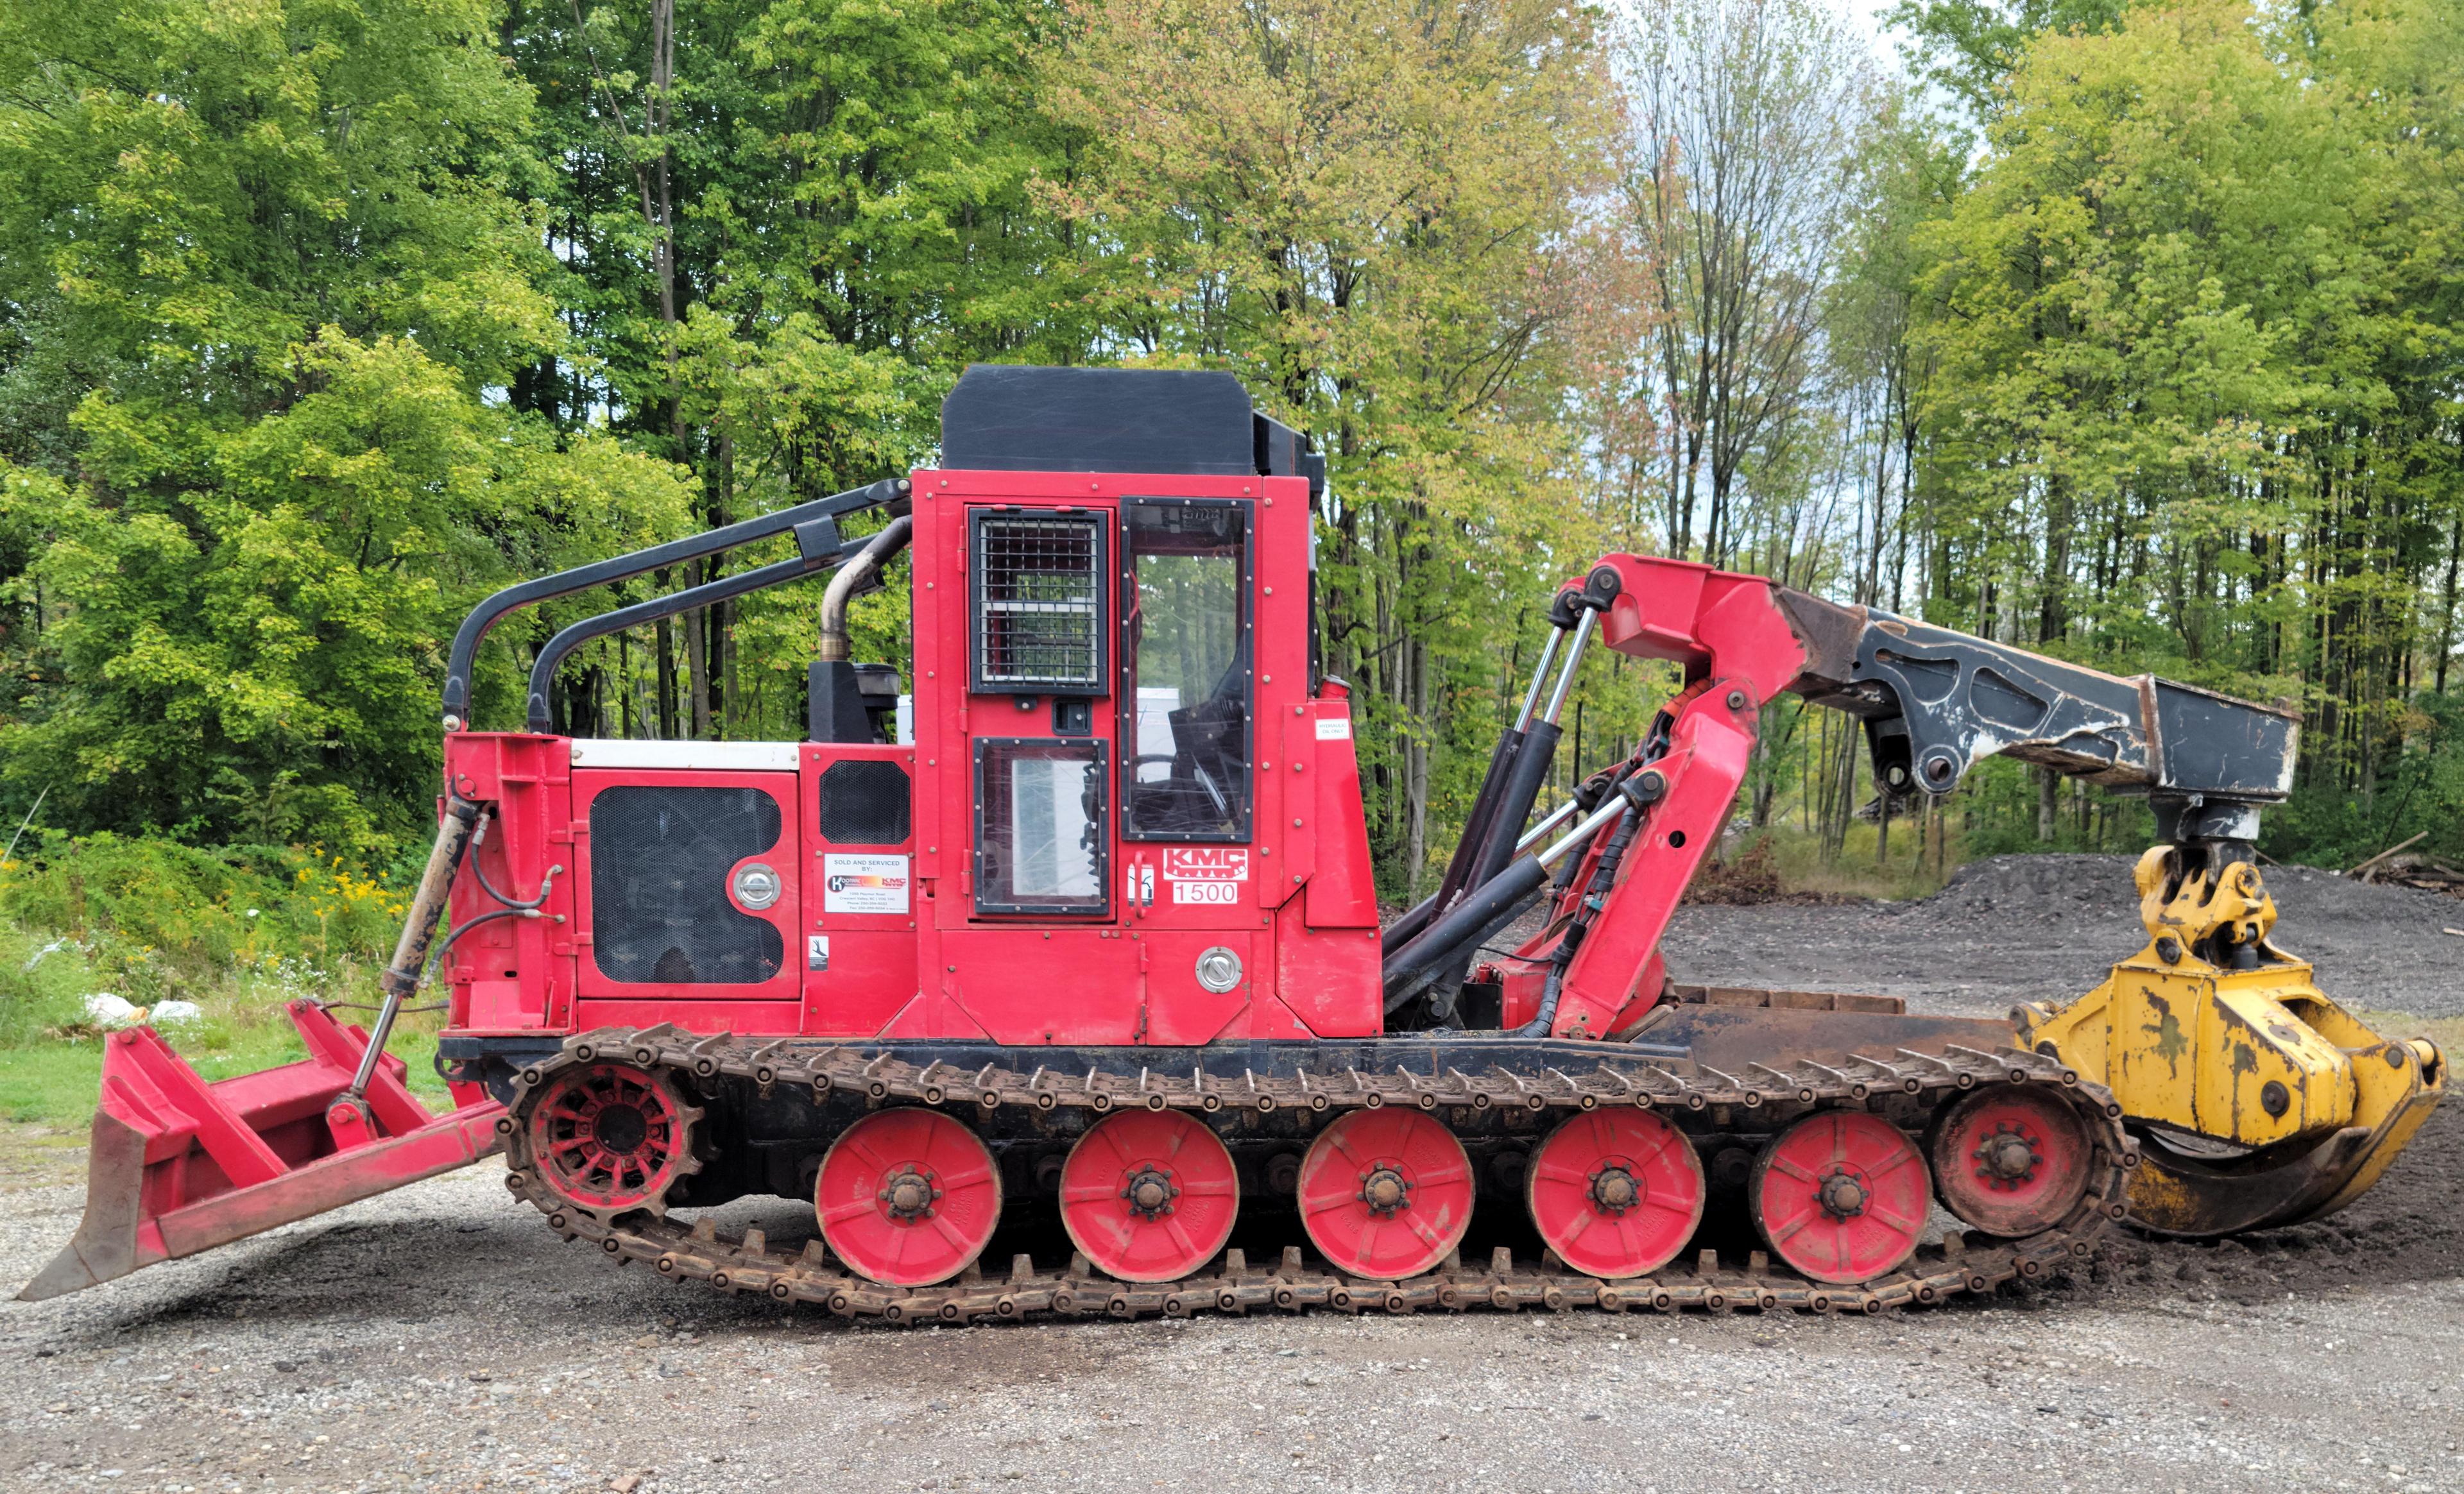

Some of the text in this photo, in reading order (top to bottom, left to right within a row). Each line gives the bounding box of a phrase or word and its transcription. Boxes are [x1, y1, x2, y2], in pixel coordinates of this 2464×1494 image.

[1166, 849, 1245, 872] KMC
[882, 878, 906, 887] KMC
[1176, 884, 1235, 901] 1500
